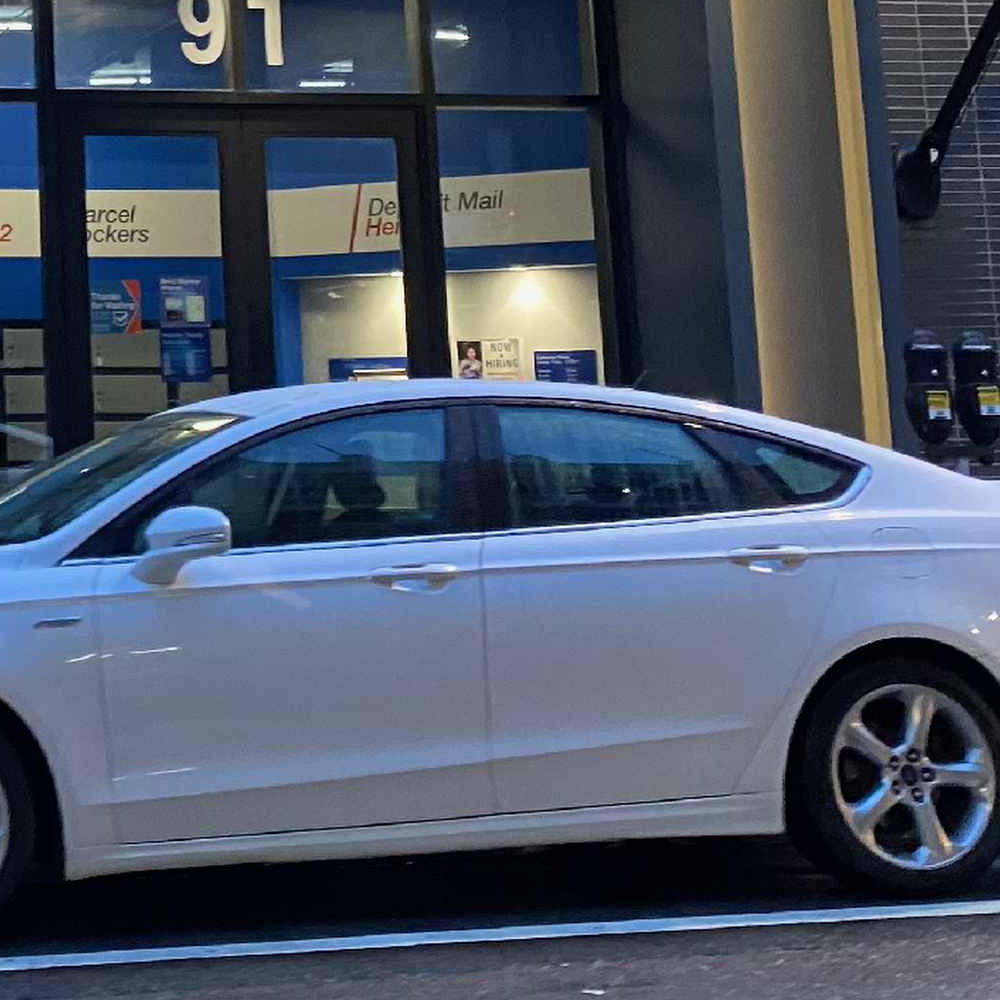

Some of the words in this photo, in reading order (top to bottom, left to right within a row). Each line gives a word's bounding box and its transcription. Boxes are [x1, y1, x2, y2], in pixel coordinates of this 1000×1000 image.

[458, 190, 504, 211] Mail
[86, 205, 136, 223] arcel
[86, 225, 149, 243] ckers
[365, 217, 400, 237] He
[490, 342, 512, 352] NOW
[485, 359, 519, 368] HIRING
